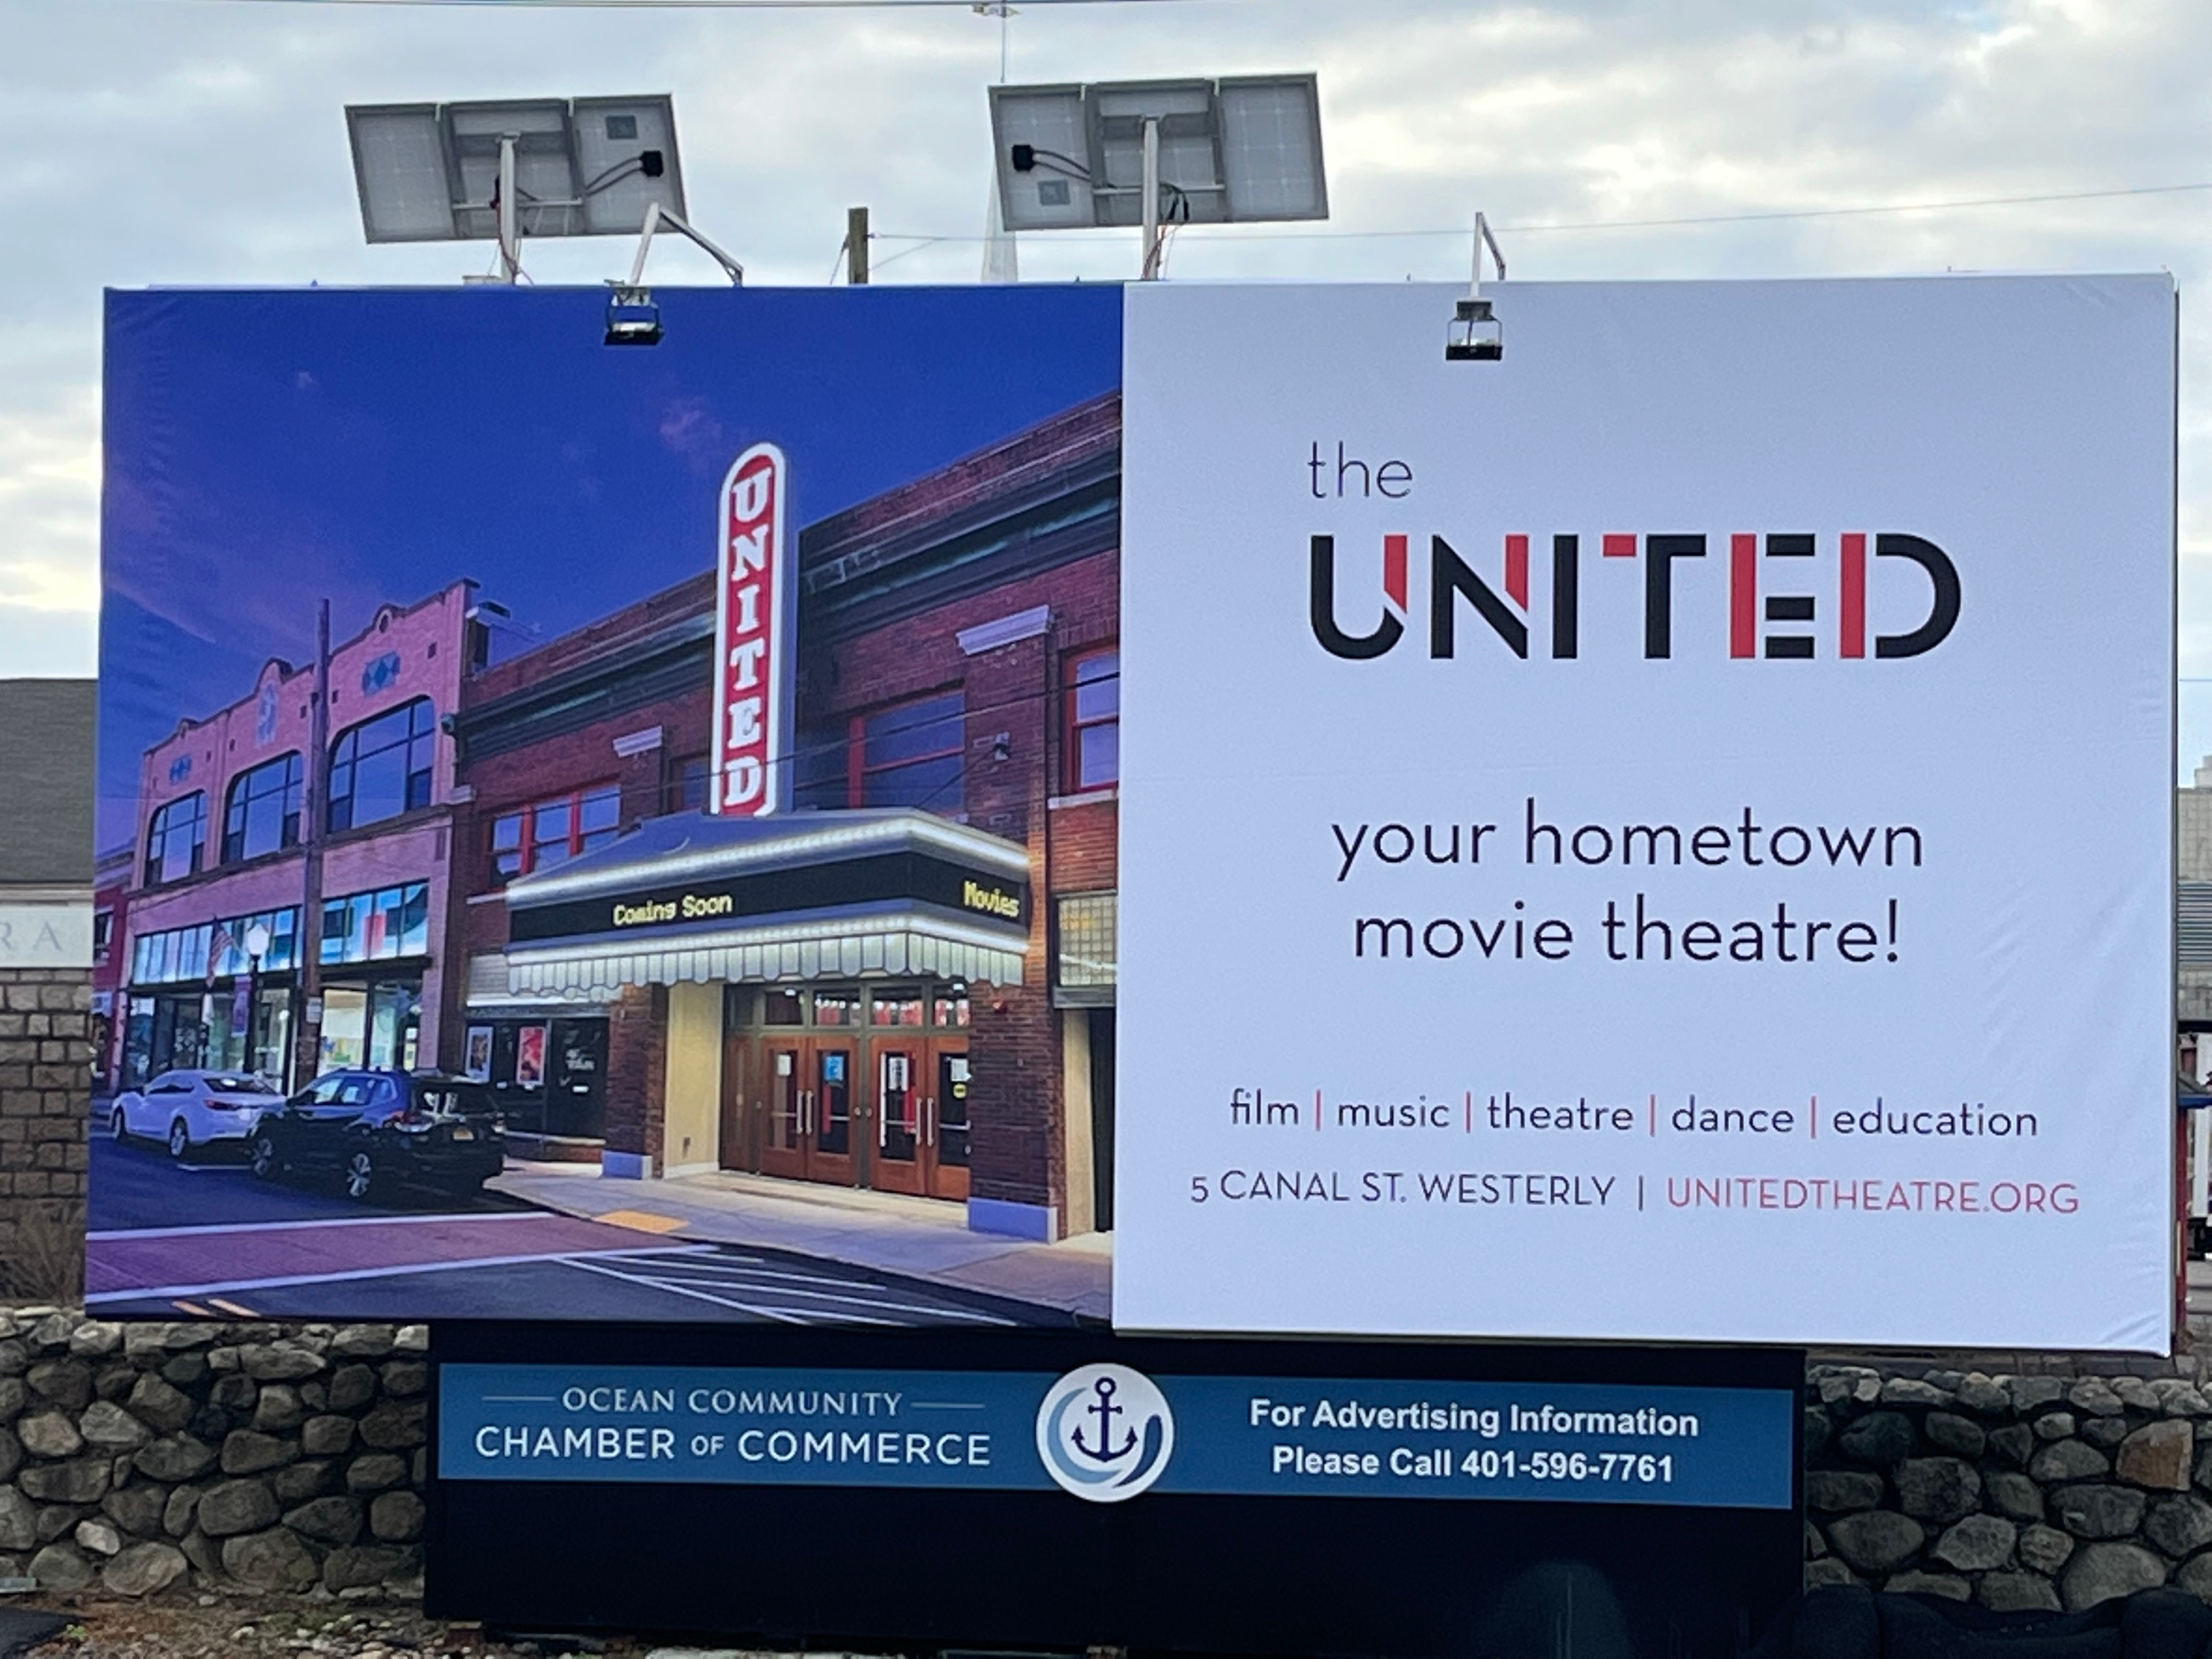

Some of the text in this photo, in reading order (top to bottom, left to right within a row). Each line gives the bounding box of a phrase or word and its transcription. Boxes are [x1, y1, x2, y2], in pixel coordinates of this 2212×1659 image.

[1308, 441, 1413, 497] the
[1310, 533, 1962, 659] UNITED
[724, 466, 772, 808] UNITED
[1331, 797, 1923, 882] your hometown
[613, 894, 733, 926] Coming Soon
[964, 880, 1019, 917] Movies
[1355, 893, 1899, 963] movie theatre!
[1231, 1088, 2038, 1136] film music theatre dance education
[1191, 1170, 2079, 1214] 5 CANAL ST. WESTERLY UNITEDTHEATRE.ORG
[561, 1387, 903, 1417] OCEAN COMMUNITY
[1250, 1398, 1699, 1437] For Advertising Information
[475, 1426, 991, 1466] CHAMBER OF COMMERCE
[1273, 1446, 1673, 1482] Please Call 401-596-7761
